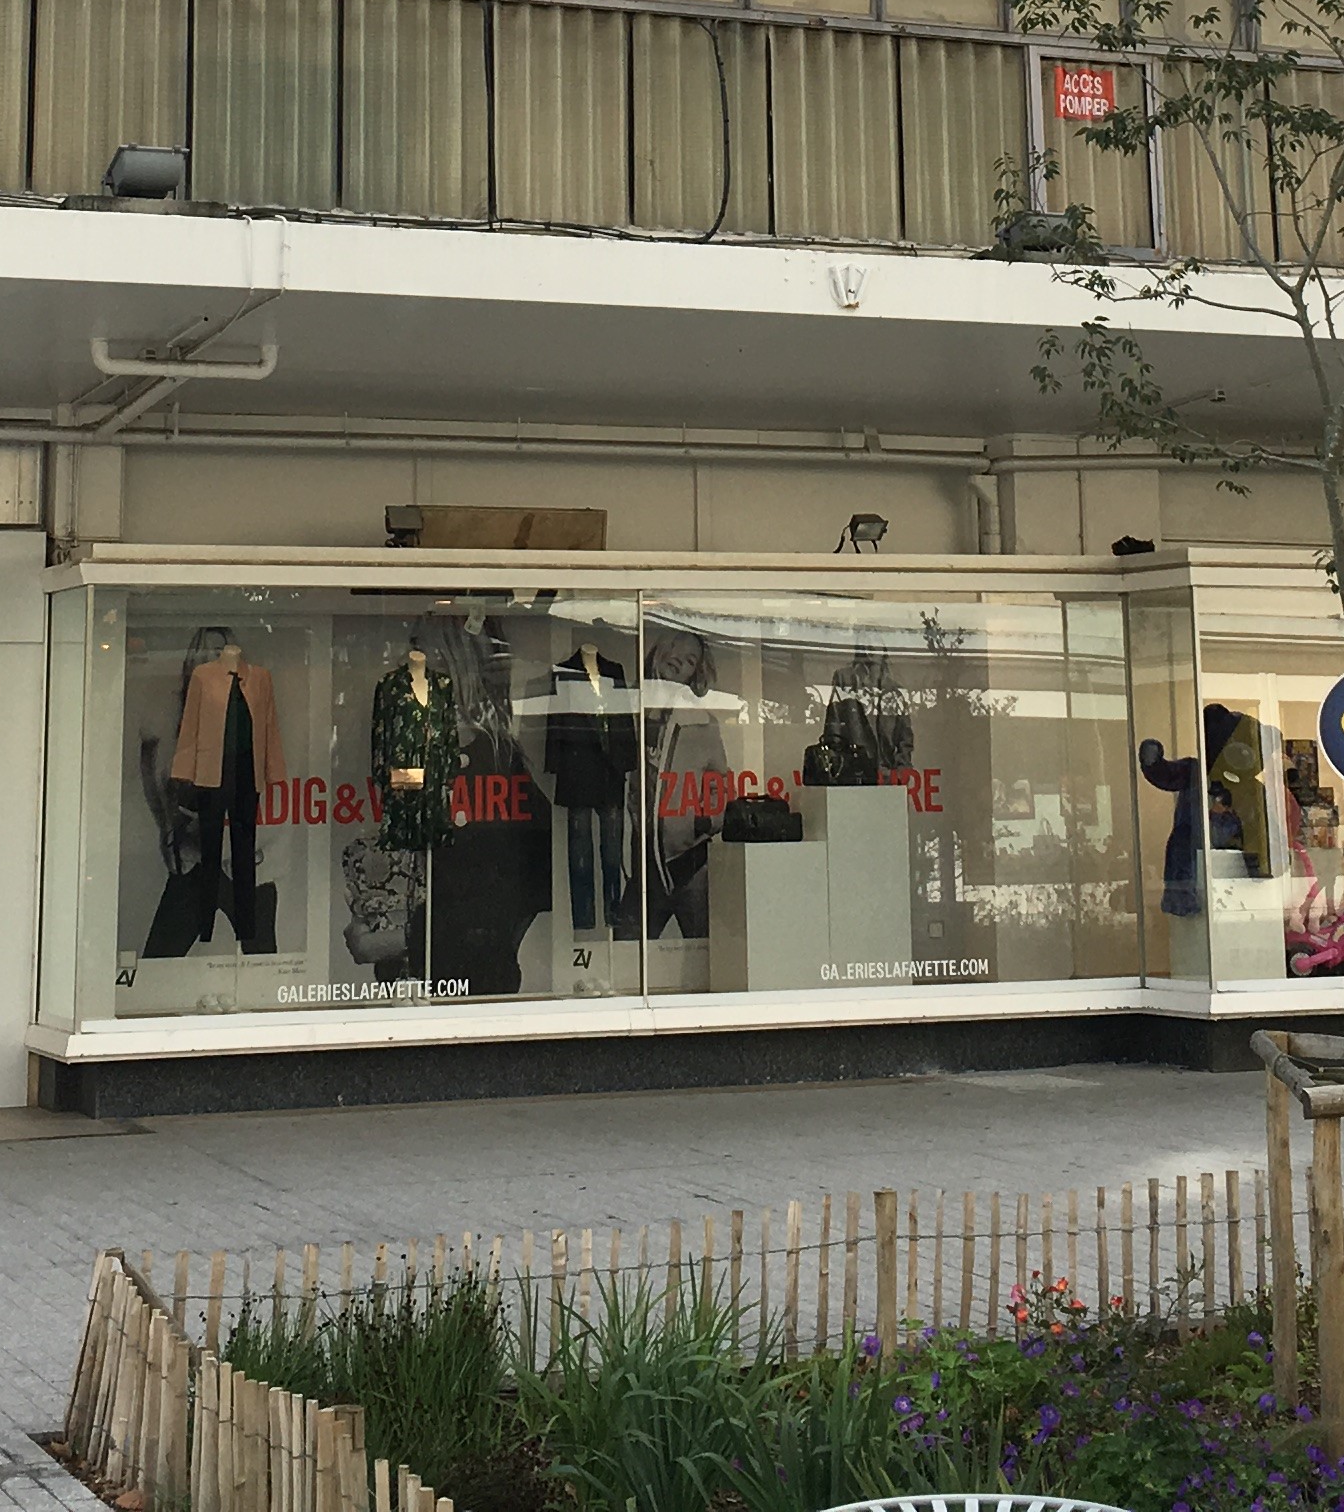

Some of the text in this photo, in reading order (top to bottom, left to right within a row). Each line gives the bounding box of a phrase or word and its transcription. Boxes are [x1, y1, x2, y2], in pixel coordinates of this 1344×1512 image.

[1059, 93, 1109, 116] POMPER
[821, 958, 989, 981] GAERIESLAFAYETTE.COM
[277, 978, 469, 1004] GALERIESLAFAYETTE.COM
